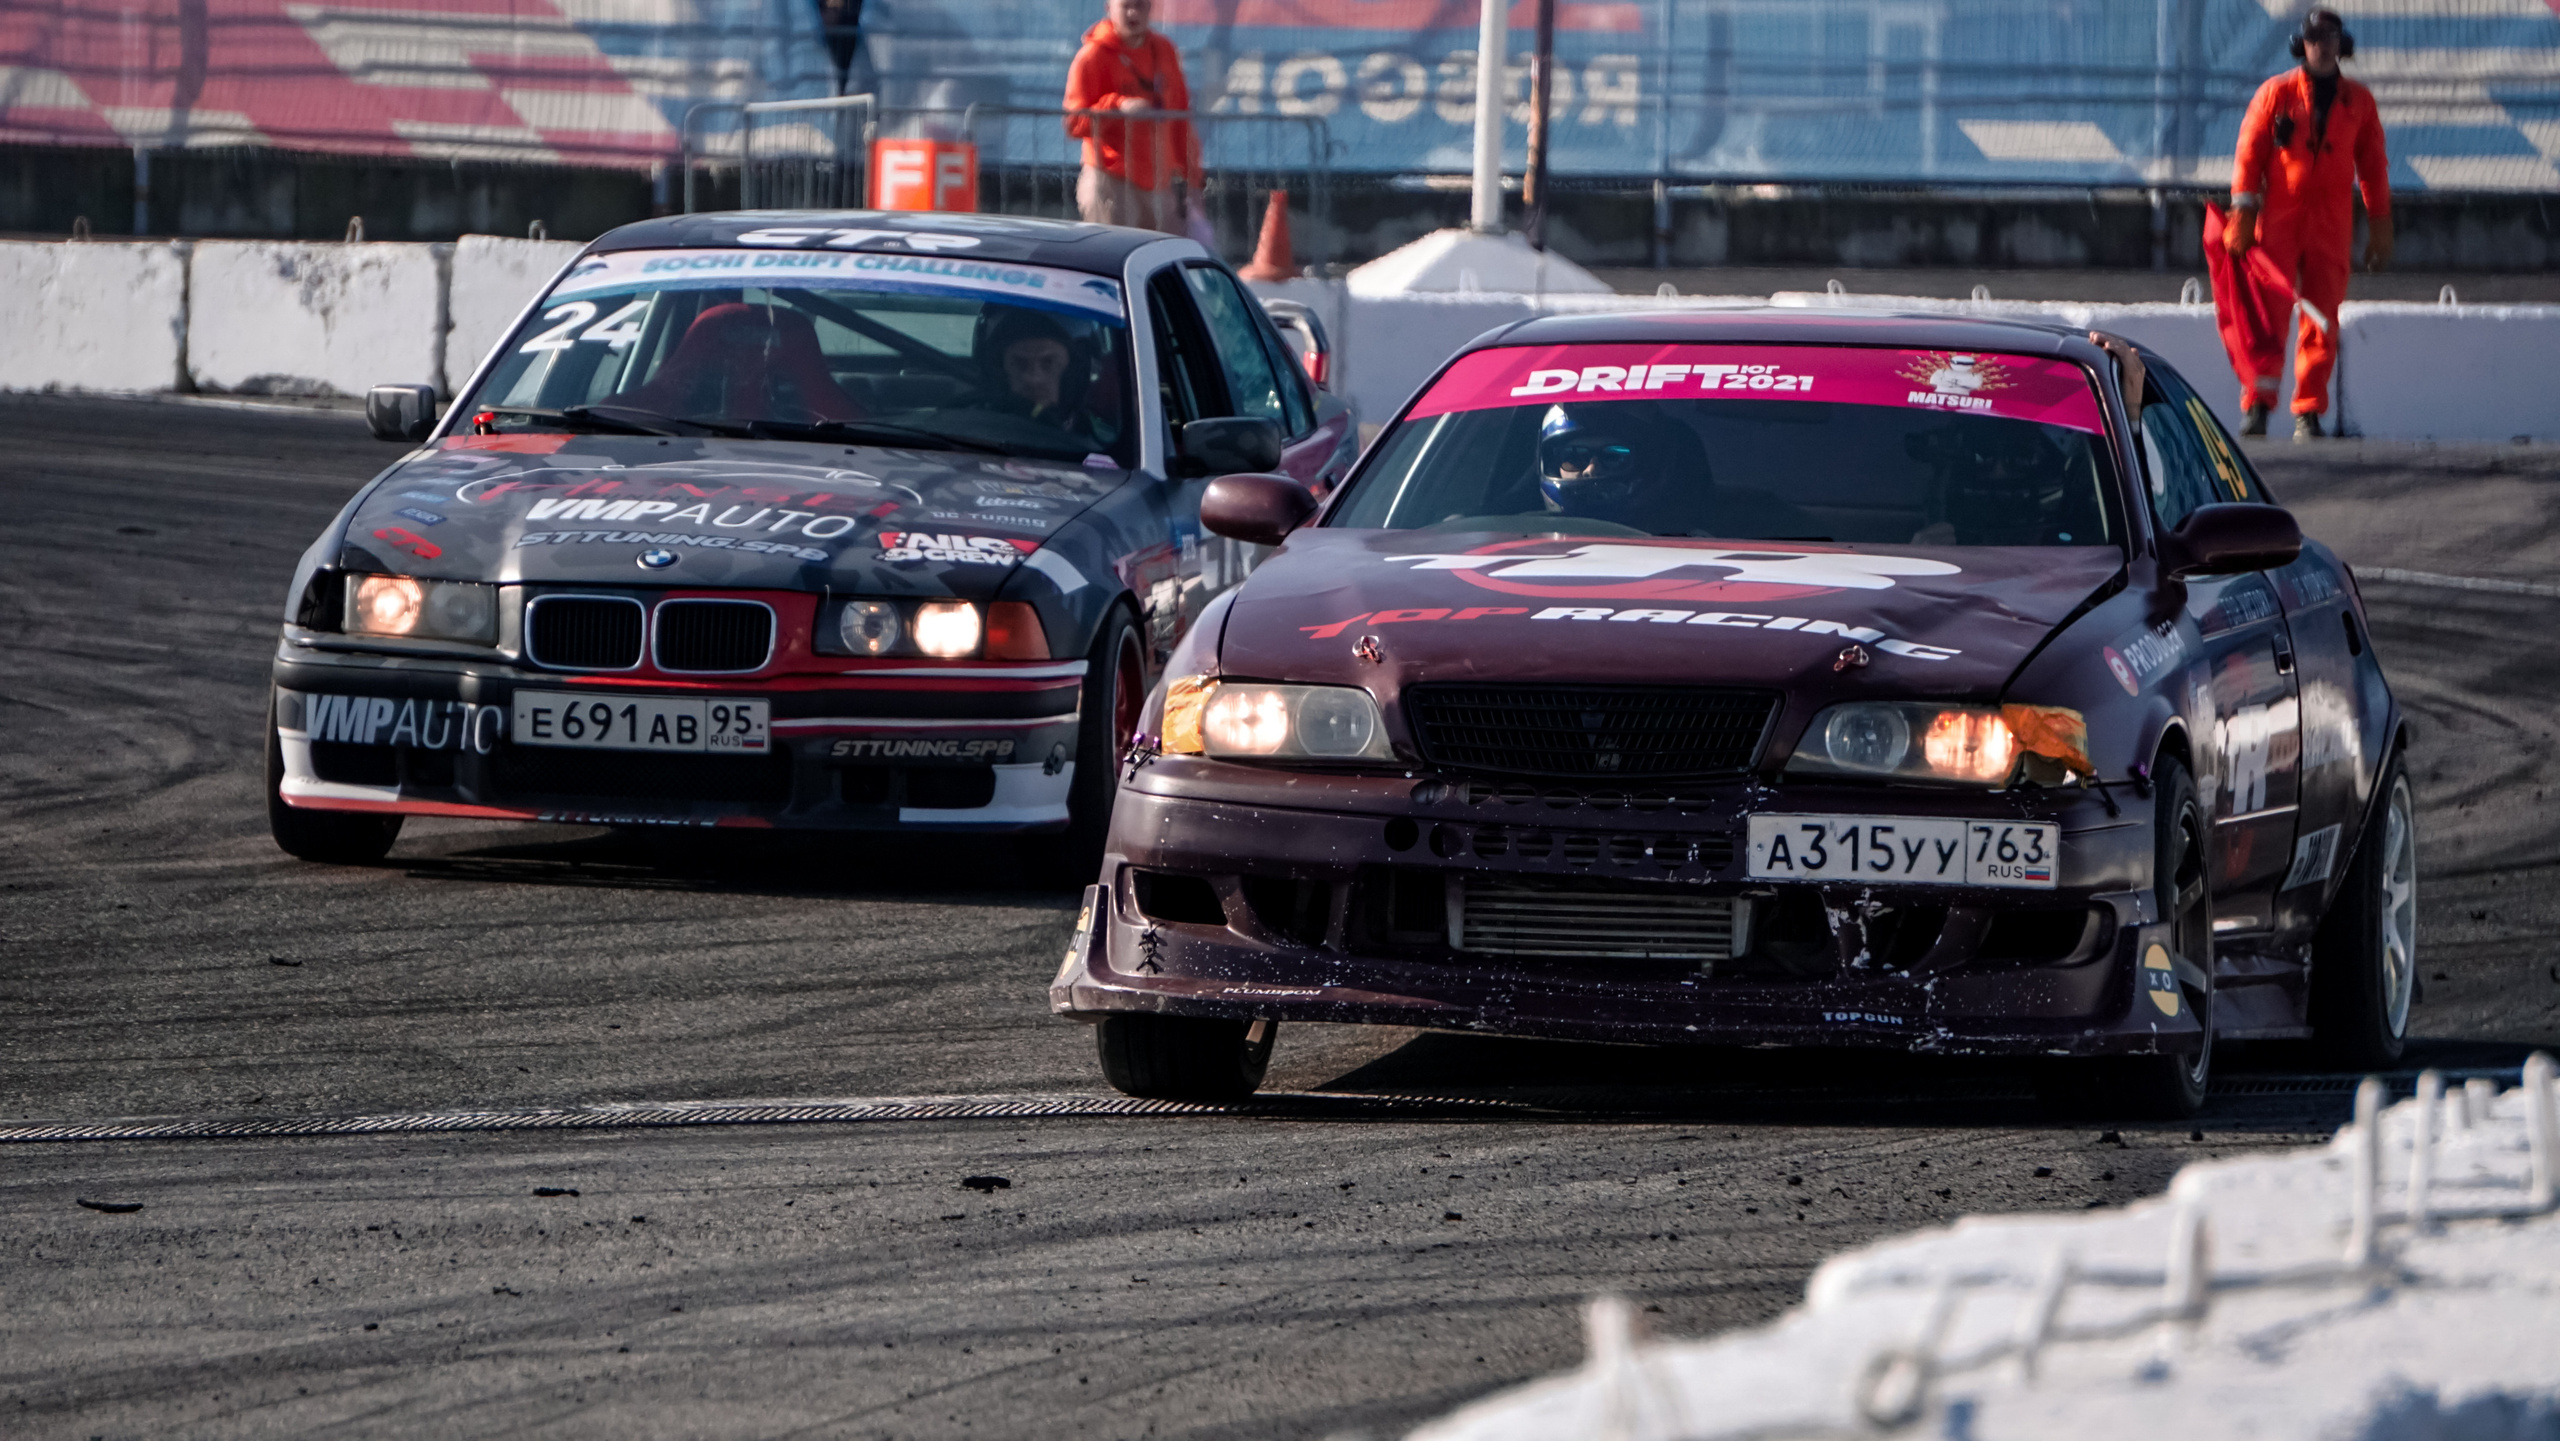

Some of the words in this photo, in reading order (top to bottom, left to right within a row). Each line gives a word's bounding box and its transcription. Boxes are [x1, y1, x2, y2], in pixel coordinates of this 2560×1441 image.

[642, 252, 744, 274] SOCHI
[752, 252, 852, 270] DRIFT
[854, 254, 1047, 288] CHALLENGE
[519, 301, 650, 354] 24
[1510, 364, 1739, 397] DRIFT
[1723, 374, 1814, 391] 2021
[1907, 391, 1993, 409] MATSURI
[514, 530, 829, 562] STTUNING.SPB
[923, 548, 1017, 567] CREW
[712, 704, 752, 735] 95
[710, 734, 741, 747] RUS
[831, 739, 1016, 758] STTUNING.SPB
[1972, 825, 2045, 864] 763
[1987, 864, 2024, 879] RUS
